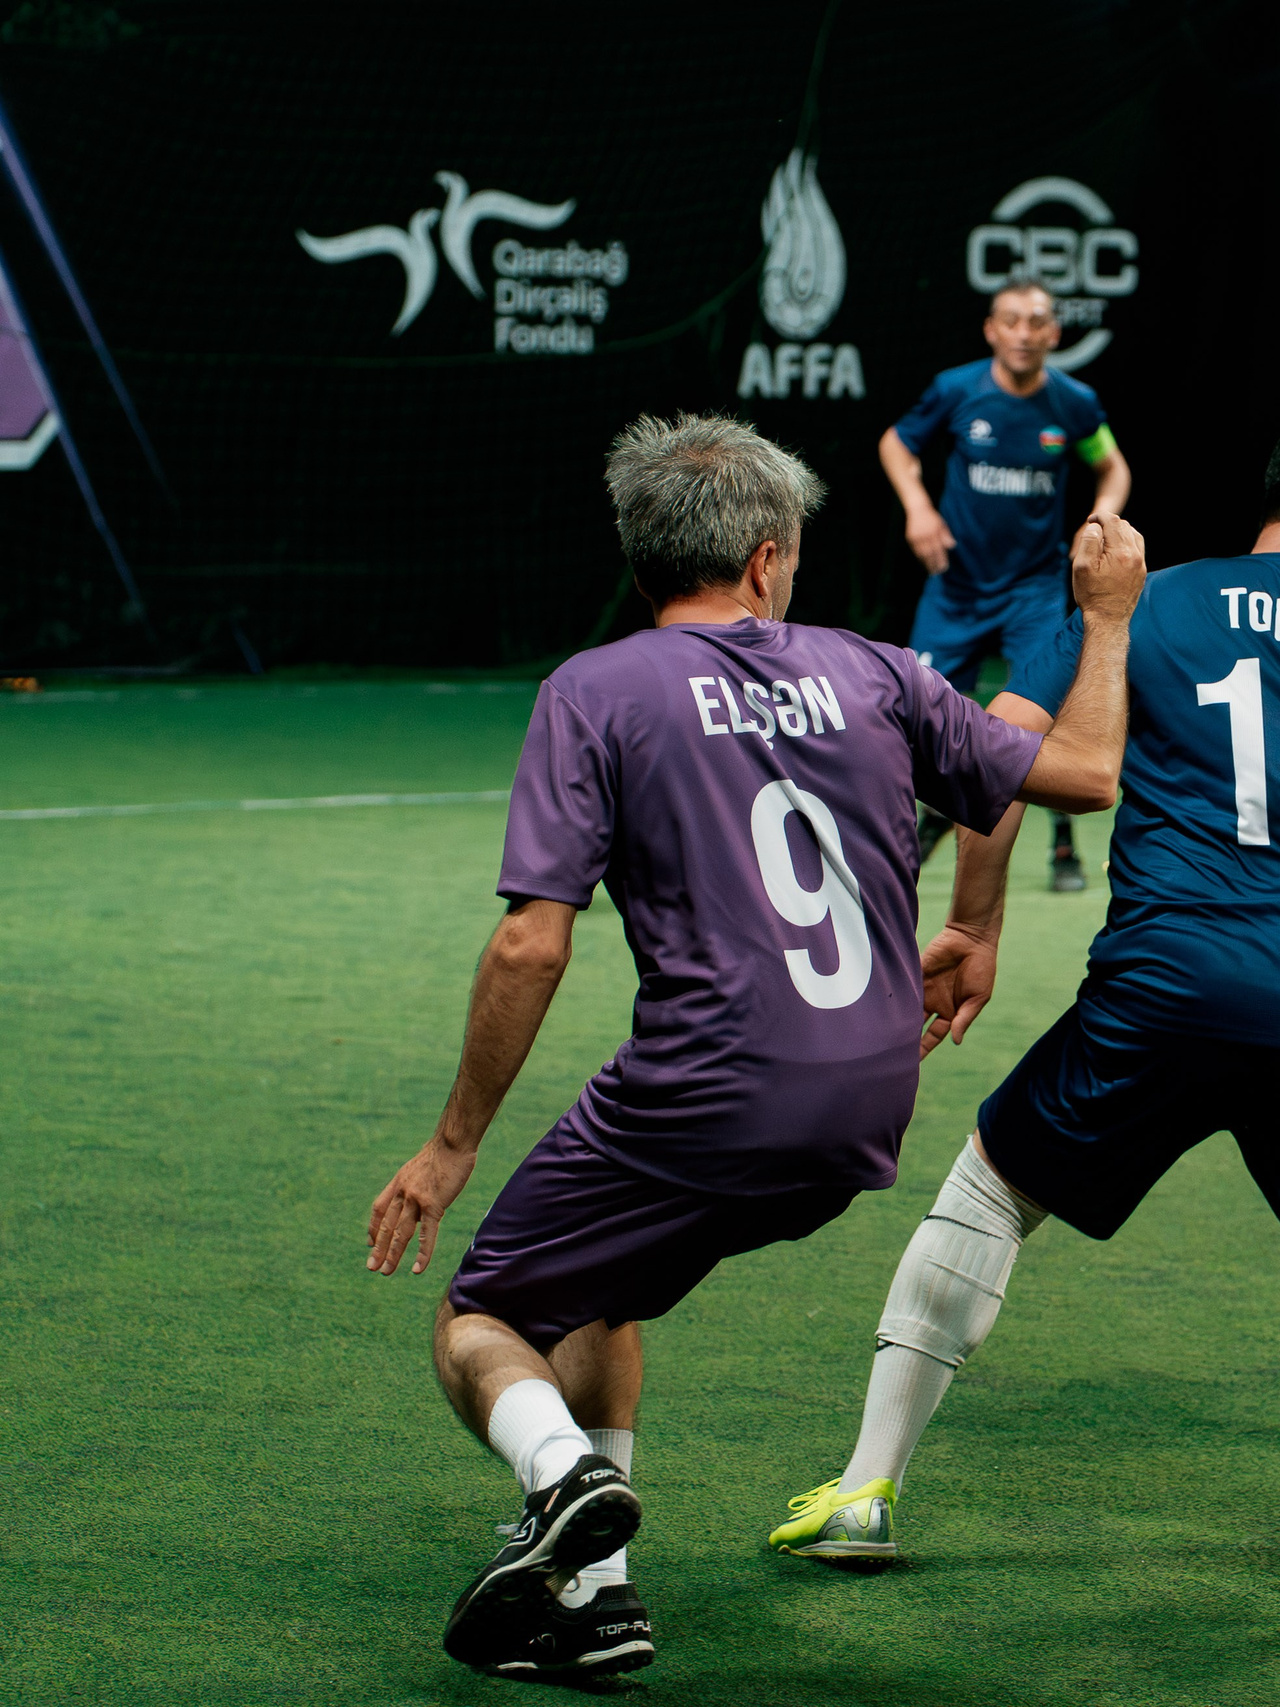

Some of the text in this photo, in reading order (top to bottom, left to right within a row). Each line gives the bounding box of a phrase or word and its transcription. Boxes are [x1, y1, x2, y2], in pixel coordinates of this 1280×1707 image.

[493, 239, 628, 287] Qarabağ
[966, 224, 1140, 297] CBC
[494, 316, 594, 353] Fondu
[737, 342, 866, 400] AFFA
[688, 676, 846, 750] ELŞƏN
[751, 779, 872, 1009] 9
